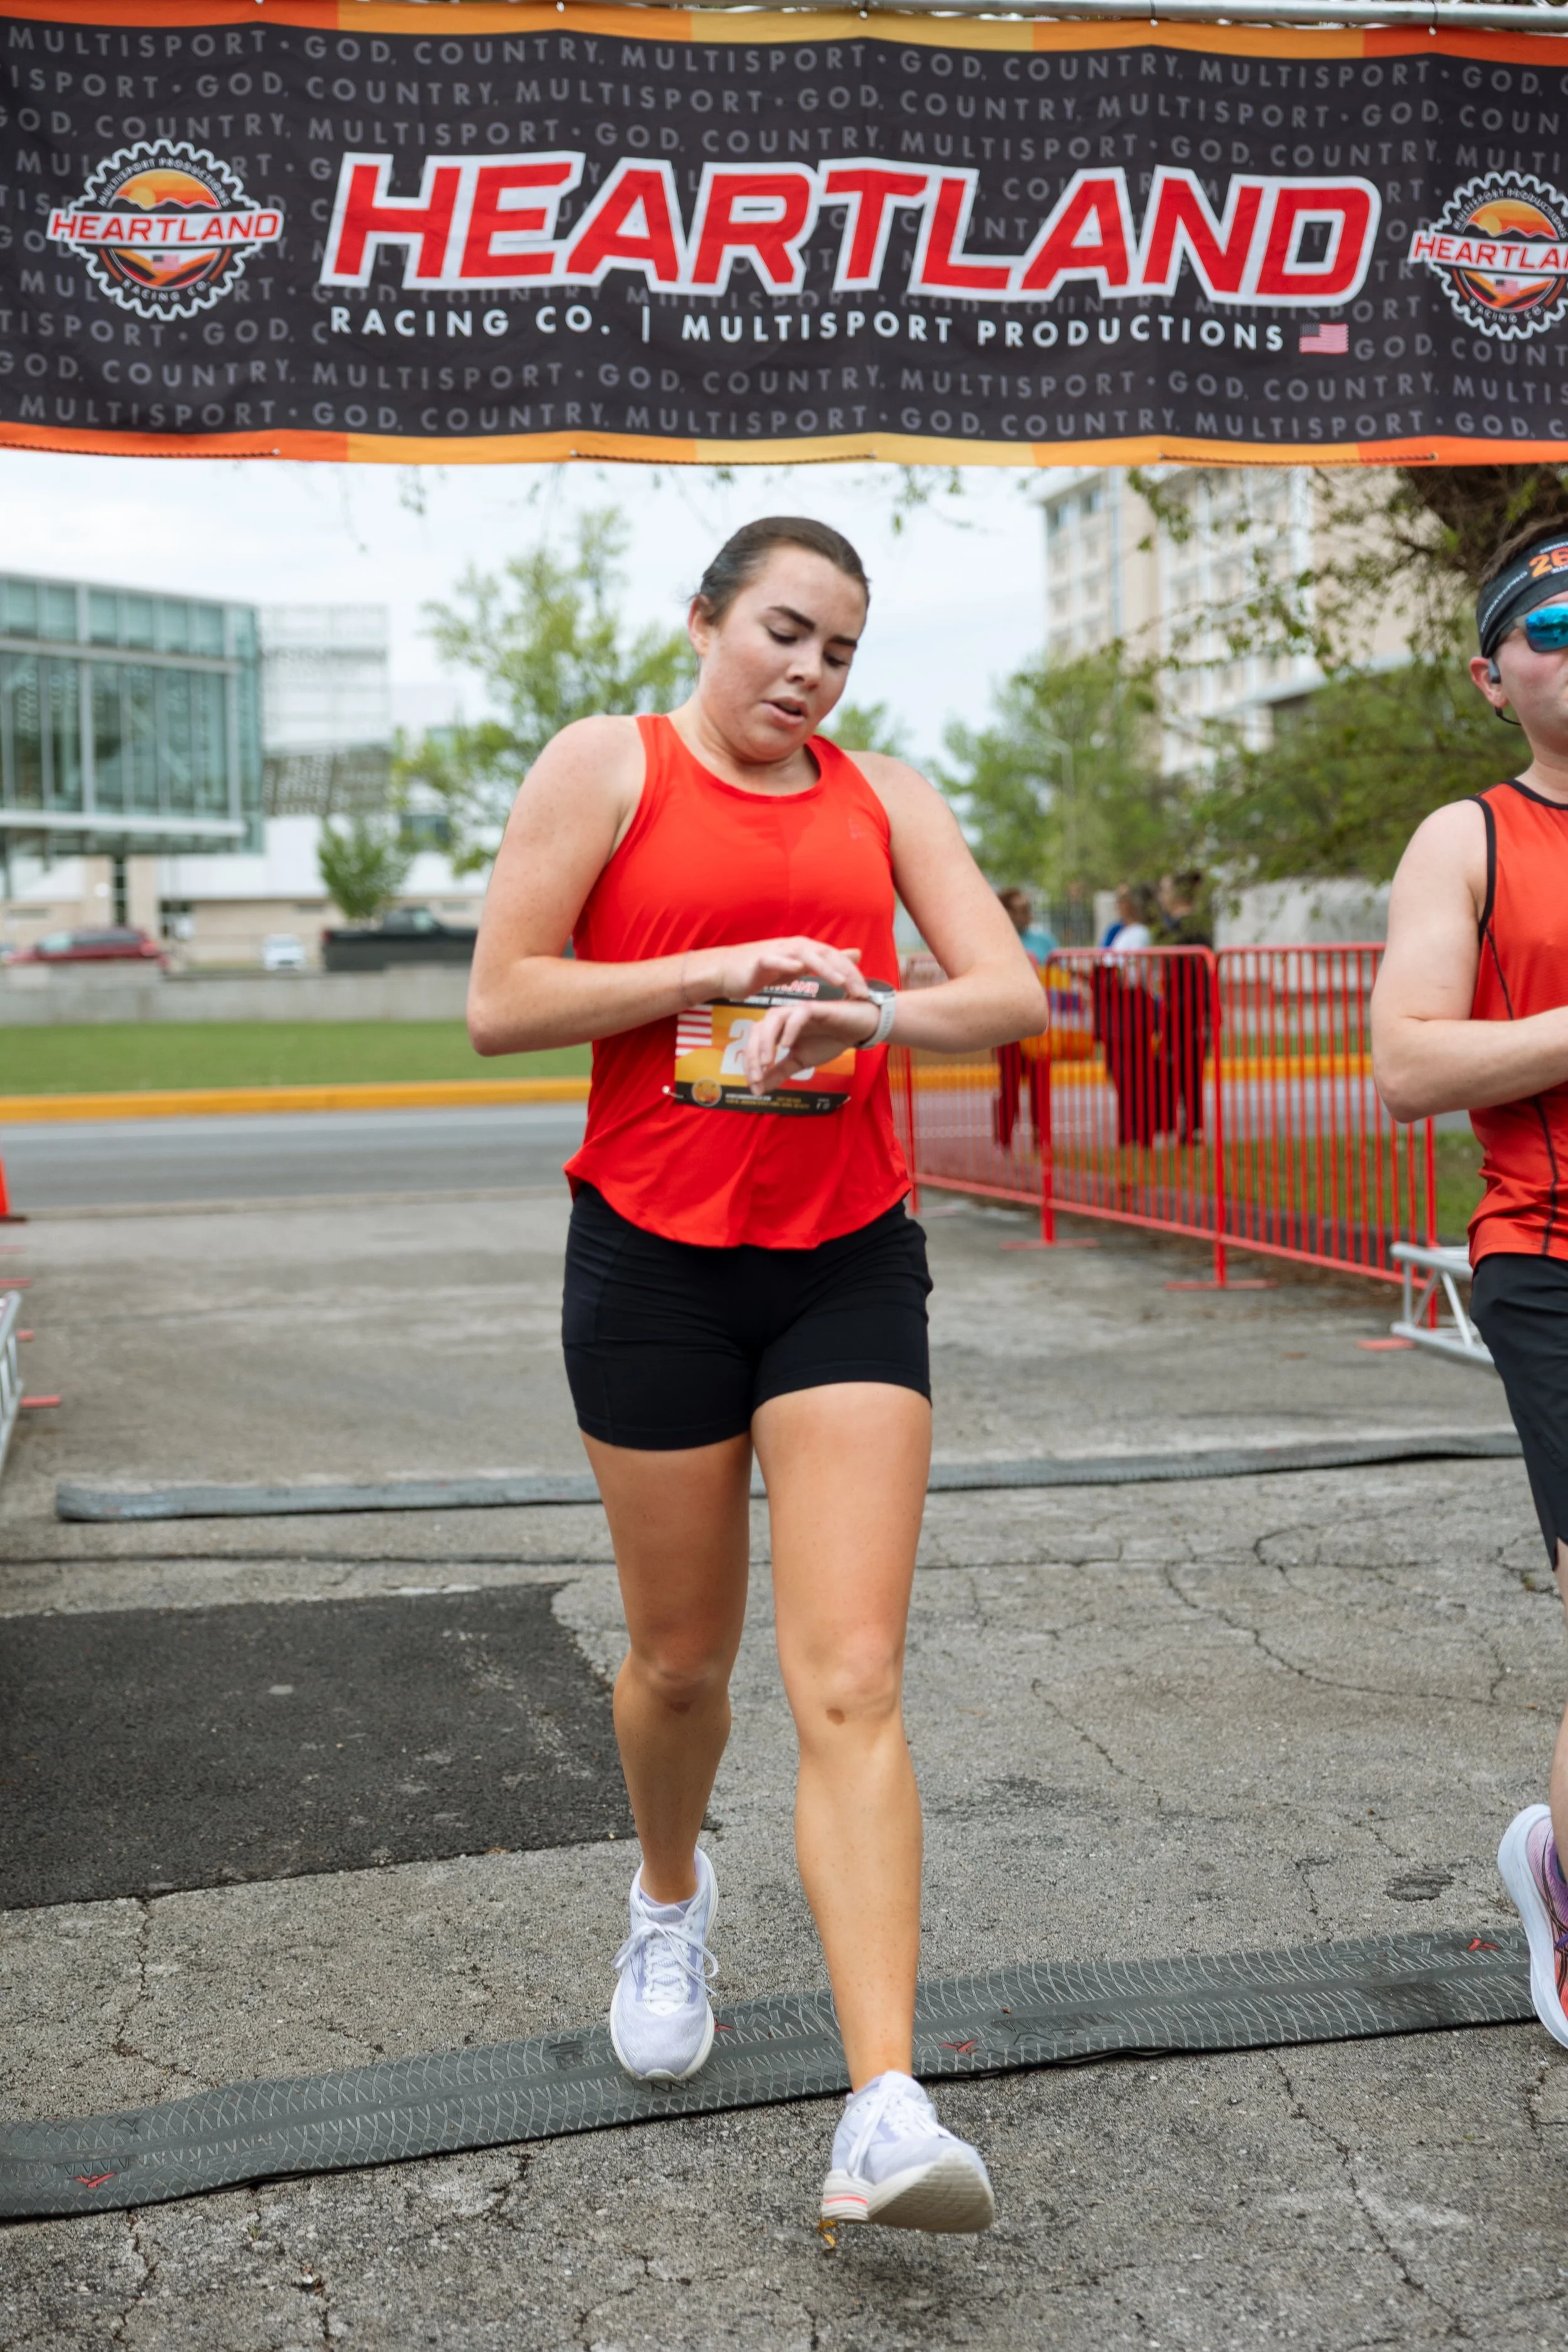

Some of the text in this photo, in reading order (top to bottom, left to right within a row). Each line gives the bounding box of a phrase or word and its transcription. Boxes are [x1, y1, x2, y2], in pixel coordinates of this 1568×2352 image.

[8, 25, 266, 58] MULTISPORT
[621, 44, 866, 73] MULTISPORT
[1199, 58, 1430, 89] MULTISPORT
[11, 65, 159, 99] ISPORT
[515, 78, 763, 114] MULTISPORT
[1096, 93, 1330, 129] MULTISPORT
[307, 117, 559, 147] MULTISPORT
[899, 130, 1138, 161] MULTISPORT
[98, 159, 156, 207] MULTISPORT
[159, 157, 231, 207] PRODUCTIONS
[51, 213, 279, 243] HEARTLAND
[319, 151, 1382, 307] HEARTLAND
[1453, 188, 1505, 231] MULTISPORT
[1414, 235, 1568, 270] HEARTLA
[122, 280, 181, 302] RACING
[1469, 298, 1517, 323] RACING
[331, 306, 509, 337] RACING
[535, 305, 610, 335] CO.
[681, 310, 952, 343] MULTISPORT
[977, 314, 1283, 351] PRODUCTIONS
[312, 361, 563, 390] MULTISPORT
[900, 368, 1135, 399] MULTISPORT
[19, 394, 276, 428] MULTISPORT
[625, 405, 867, 435] MULTISPORT
[1195, 410, 1424, 439] MULTISPORT
